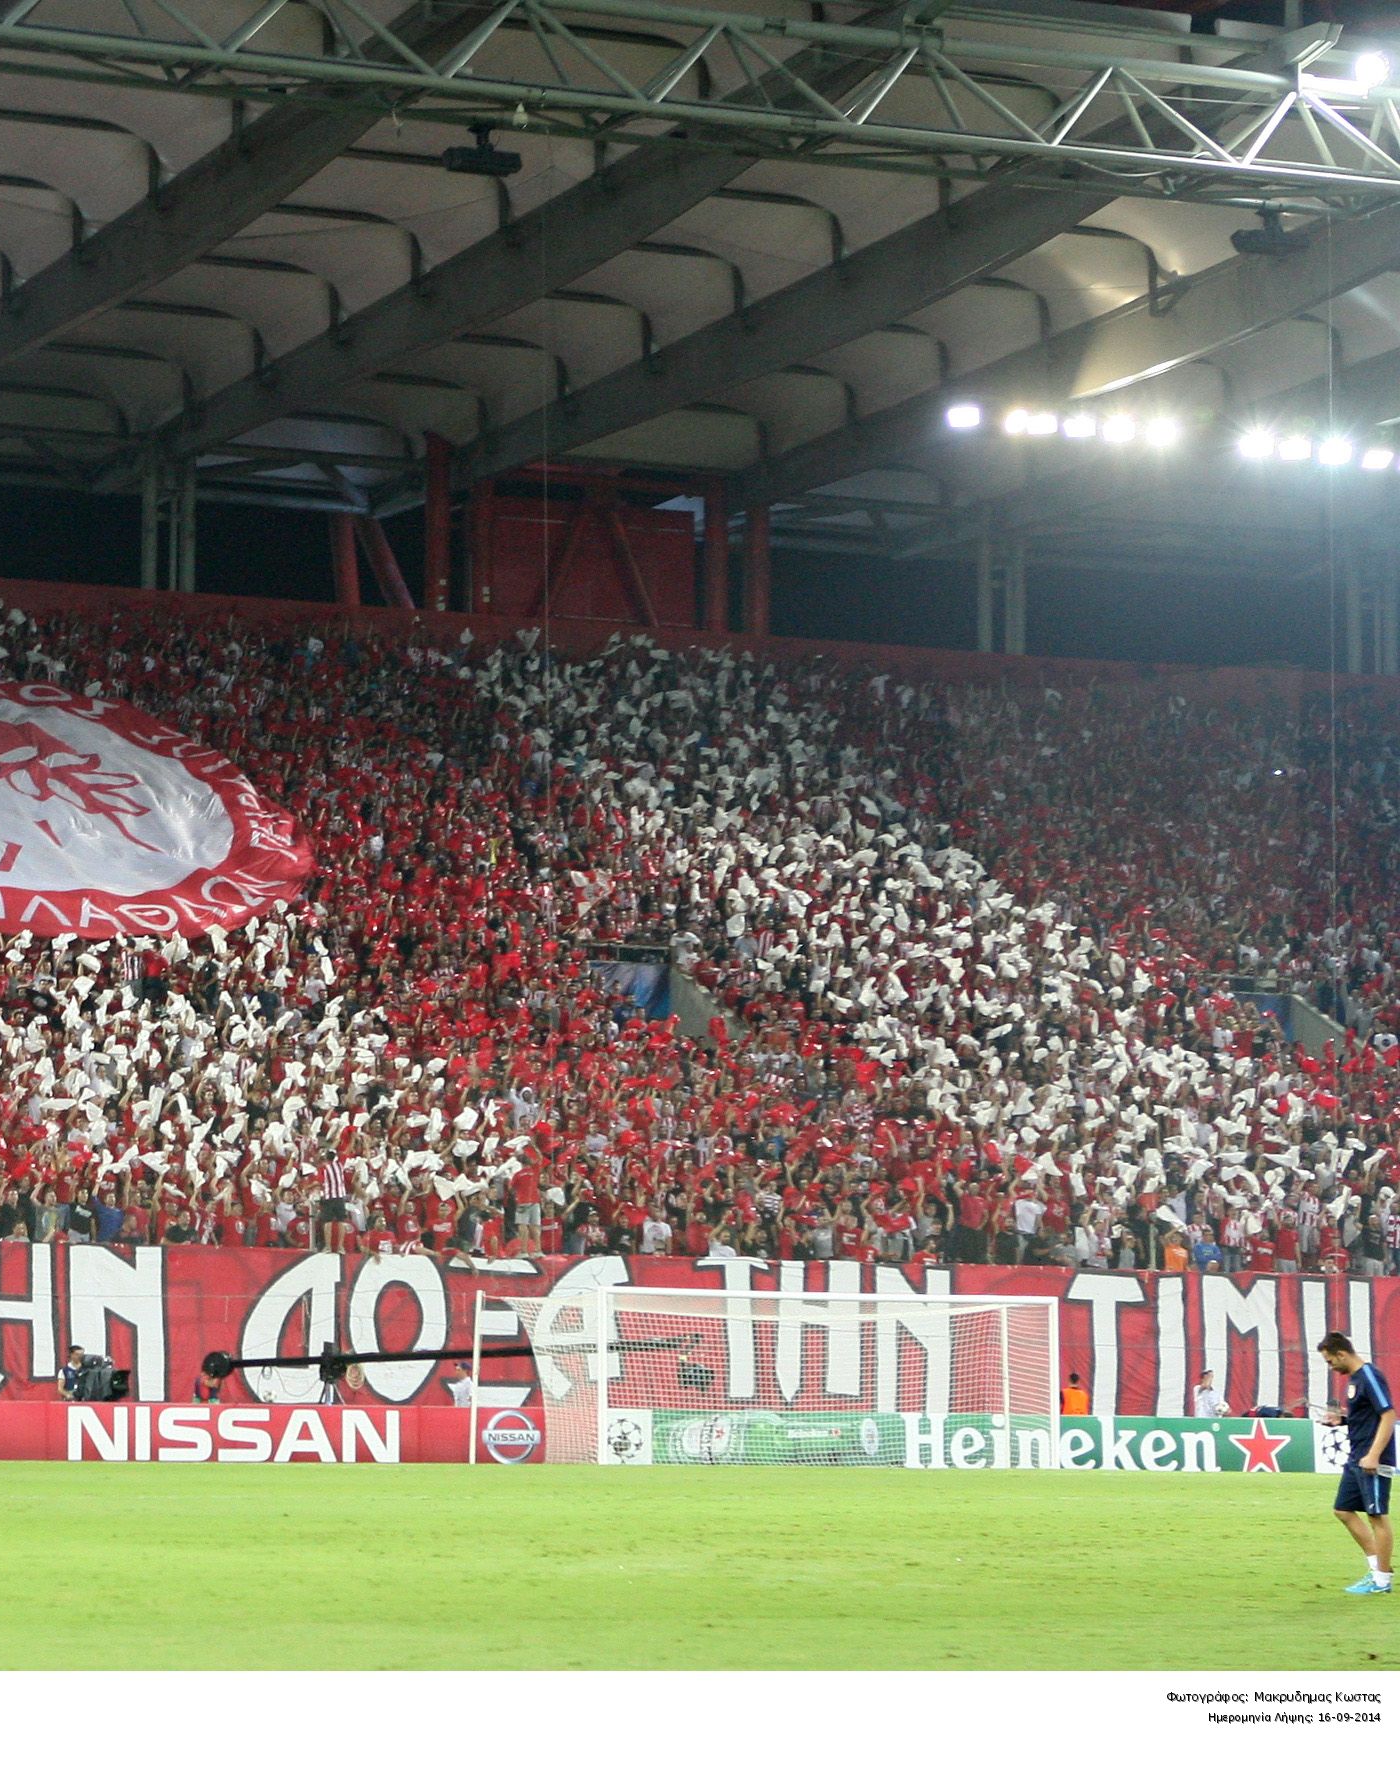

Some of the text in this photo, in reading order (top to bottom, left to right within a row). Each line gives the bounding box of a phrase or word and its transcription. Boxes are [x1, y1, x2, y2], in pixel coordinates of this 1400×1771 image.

[697, 1257, 951, 1412] ΤΗΝ
[1068, 1270, 1372, 1418] ΤΙΜΗ
[67, 1406, 400, 1463] NISSAN
[487, 1432, 537, 1443] NISSAN
[902, 1412, 1222, 1473] Heineken
